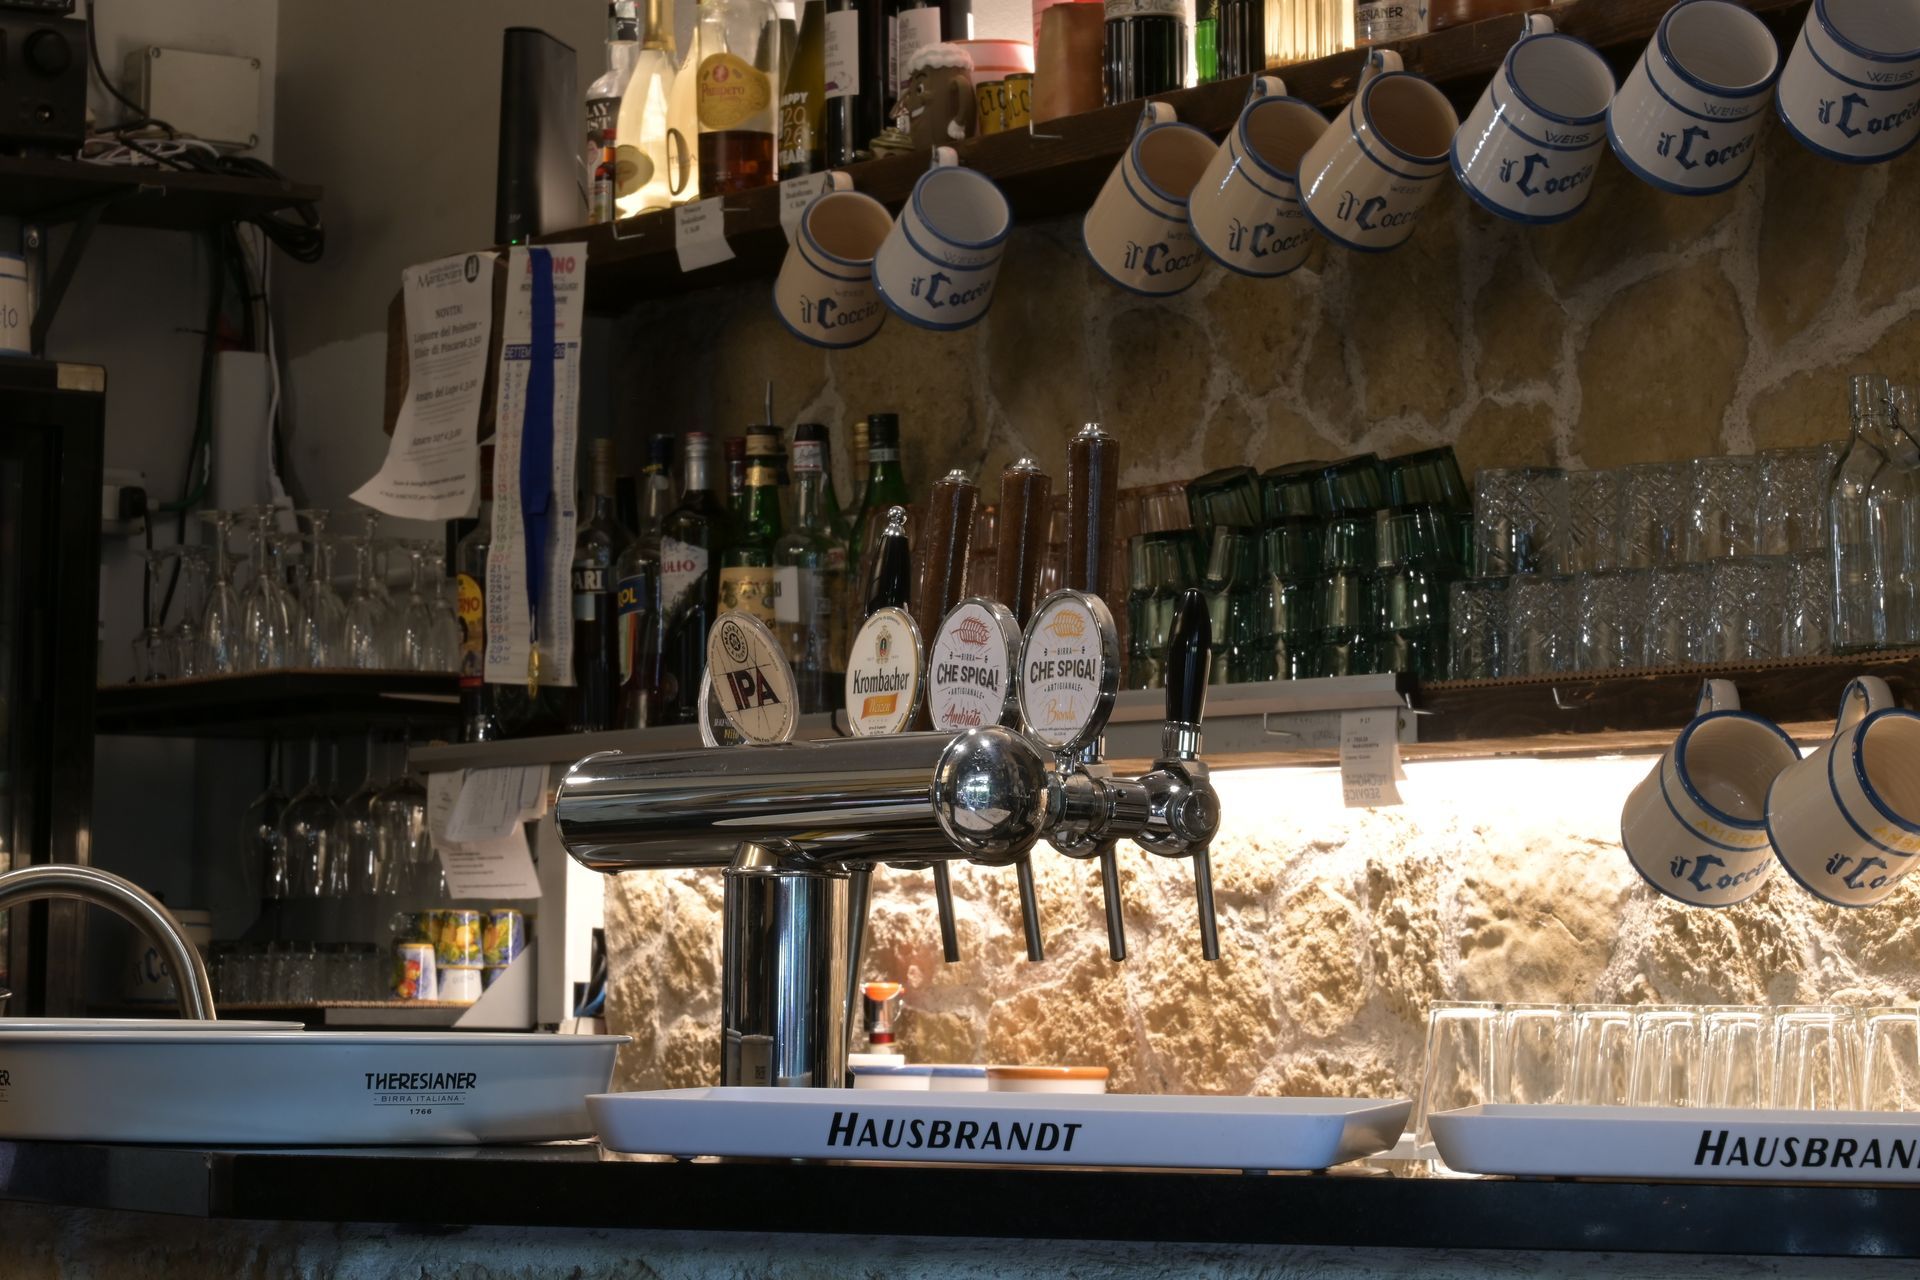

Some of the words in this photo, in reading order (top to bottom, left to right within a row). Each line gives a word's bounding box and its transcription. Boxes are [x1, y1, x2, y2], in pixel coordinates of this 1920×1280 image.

[701, 82, 745, 104] Pampero
[1818, 98, 1836, 124] il
[1545, 130, 1591, 143] WEISS
[1657, 132, 1676, 157] il
[1500, 158, 1518, 182] il
[1337, 190, 1360, 221] il
[1229, 217, 1248, 252] il
[1124, 241, 1143, 269] il
[800, 294, 817, 324] il
[574, 570, 604, 589] ARI
[853, 666, 910, 694] Krombacher
[937, 663, 959, 685] CHE
[961, 666, 998, 692] SPIGA!
[1031, 661, 1054, 683] CHE
[1057, 658, 1096, 681] SPIGA!
[727, 667, 781, 711] IPA
[1695, 820, 1766, 844] AMBRA
[365, 1072, 477, 1090] THERESIANER
[381, 1095, 412, 1103] BIRRA
[416, 1095, 459, 1103] ITALIANA
[827, 1112, 1083, 1152] HAUSBRANDT
[1694, 1130, 1920, 1168] HAUSBRAN
